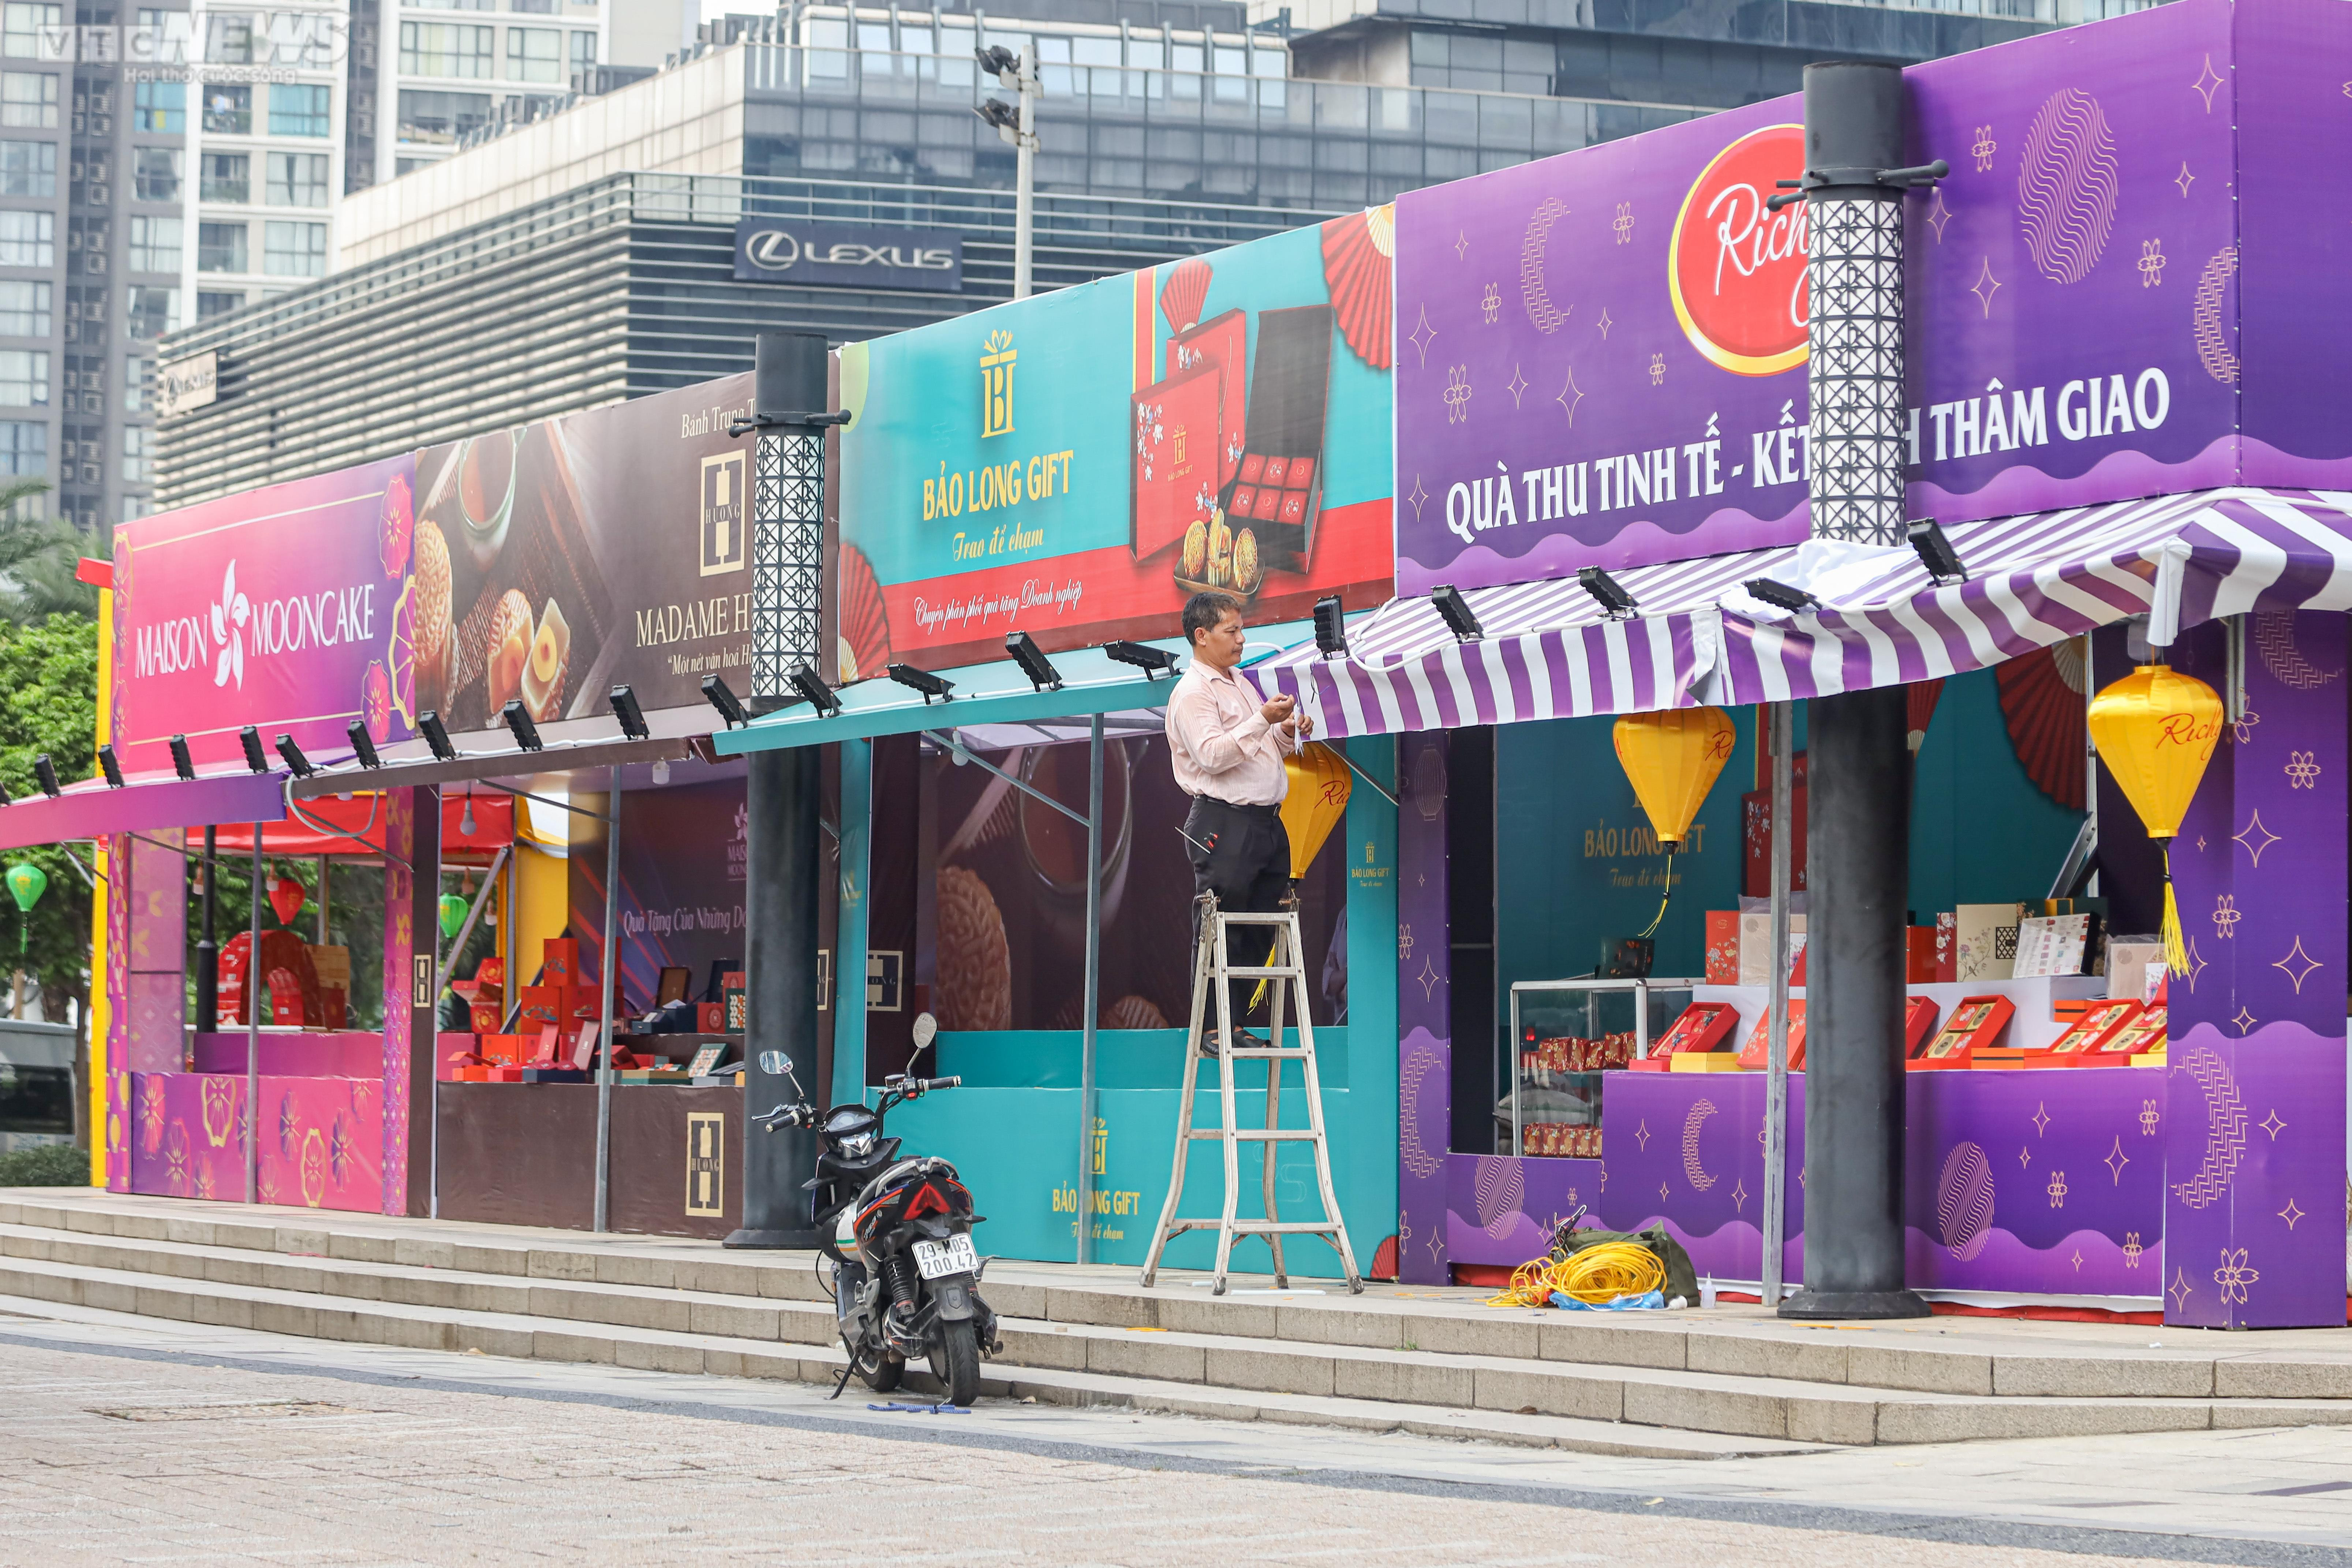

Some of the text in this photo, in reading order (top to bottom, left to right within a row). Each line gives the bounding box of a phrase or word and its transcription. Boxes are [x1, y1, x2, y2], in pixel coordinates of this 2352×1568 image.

[805, 242, 954, 270] LEXUS
[1707, 169, 1809, 328] Rich
[681, 409, 708, 439] Bánh
[1929, 377, 2049, 461] THÂM
[2056, 367, 2170, 441] GIAO
[923, 449, 1074, 521] BẢO LONG GIFT
[1446, 460, 1518, 544] QUÀ
[1522, 461, 1589, 523] THU
[1594, 446, 1677, 512] TINH
[1683, 411, 1724, 498] TẾ
[706, 503, 740, 524] HUONG
[952, 522, 1044, 562] Trao để chạm
[636, 597, 729, 647] MADAME
[914, 578, 1083, 636] Chuyên phân phối quà tặng Doanh nghiệp
[135, 584, 374, 679] MAISON MOONCAKE
[691, 652, 704, 673] nét
[722, 647, 739, 668] hoá
[1585, 818, 1618, 858] BẢO
[1052, 1180, 1077, 1213] BẢO
[1113, 1190, 1140, 1215] GIFT
[923, 1253, 976, 1276] 200.42
